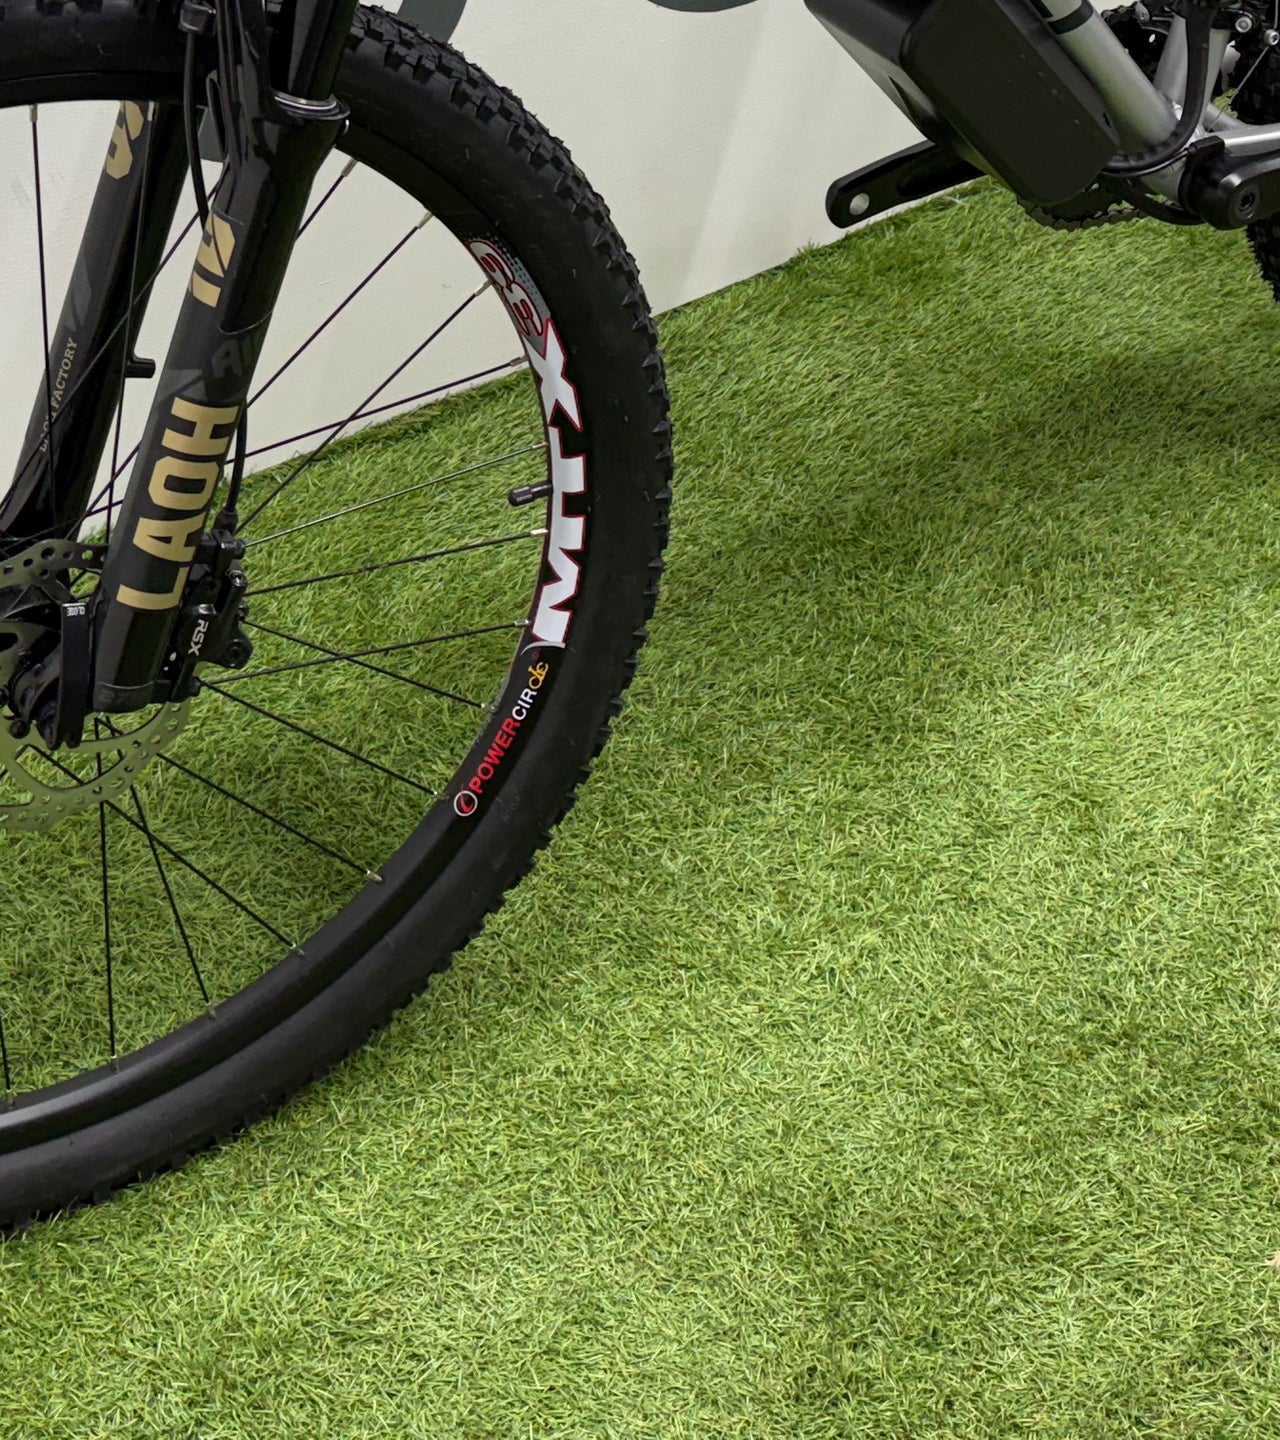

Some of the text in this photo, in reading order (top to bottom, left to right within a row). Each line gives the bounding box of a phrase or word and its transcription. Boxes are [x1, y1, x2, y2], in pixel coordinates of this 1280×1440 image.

[50, 337, 78, 409] FACTORY
[116, 396, 240, 613] LAOH
[187, 618, 210, 657] RSX
